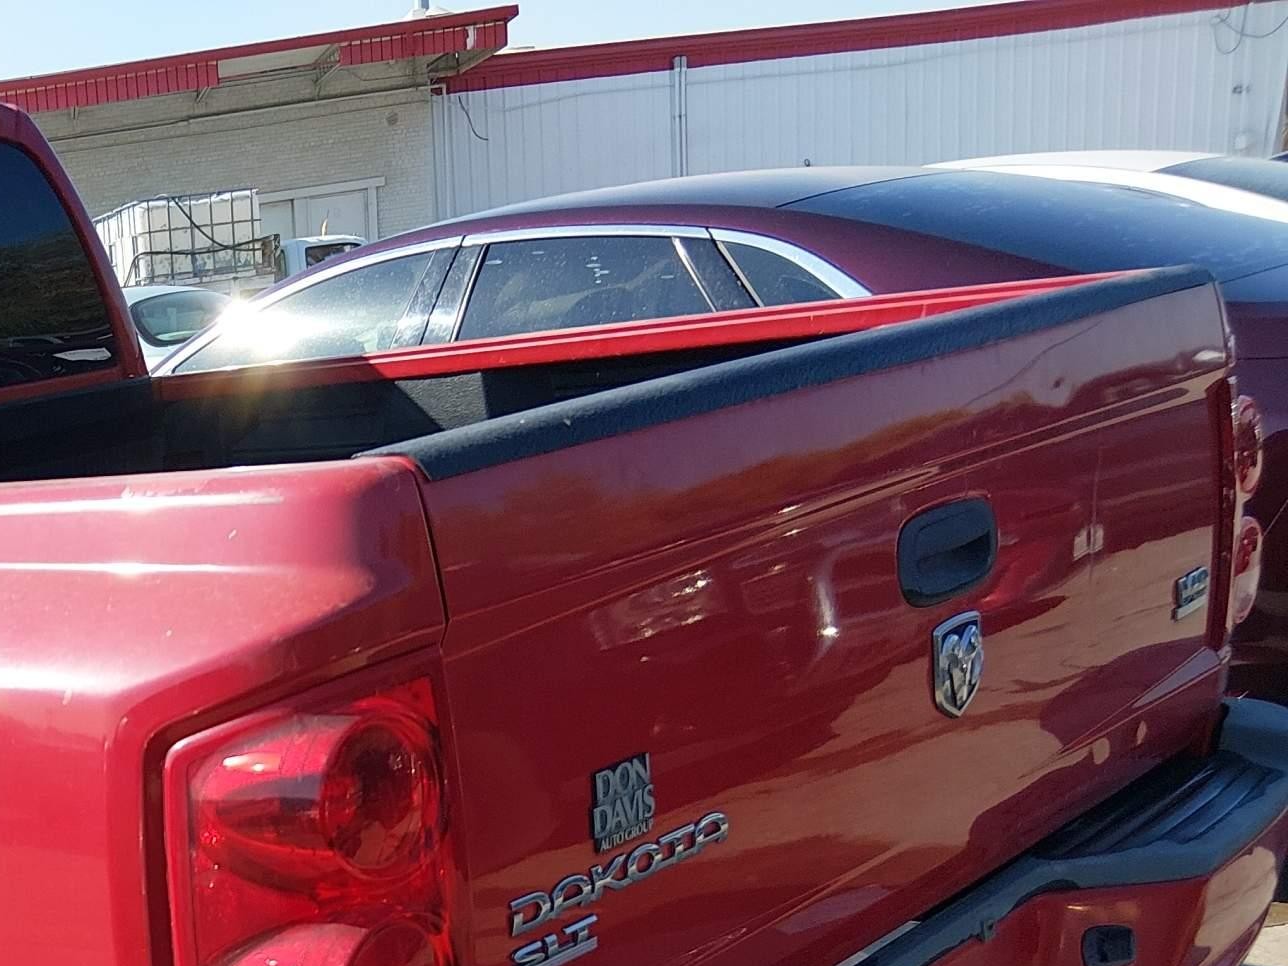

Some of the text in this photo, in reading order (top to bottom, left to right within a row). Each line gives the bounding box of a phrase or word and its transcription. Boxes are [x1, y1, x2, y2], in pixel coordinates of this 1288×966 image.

[594, 751, 651, 806] DON
[592, 783, 656, 839] DAVIS
[598, 818, 654, 854] AUTO GROUP
[509, 810, 730, 938] DAKOTA
